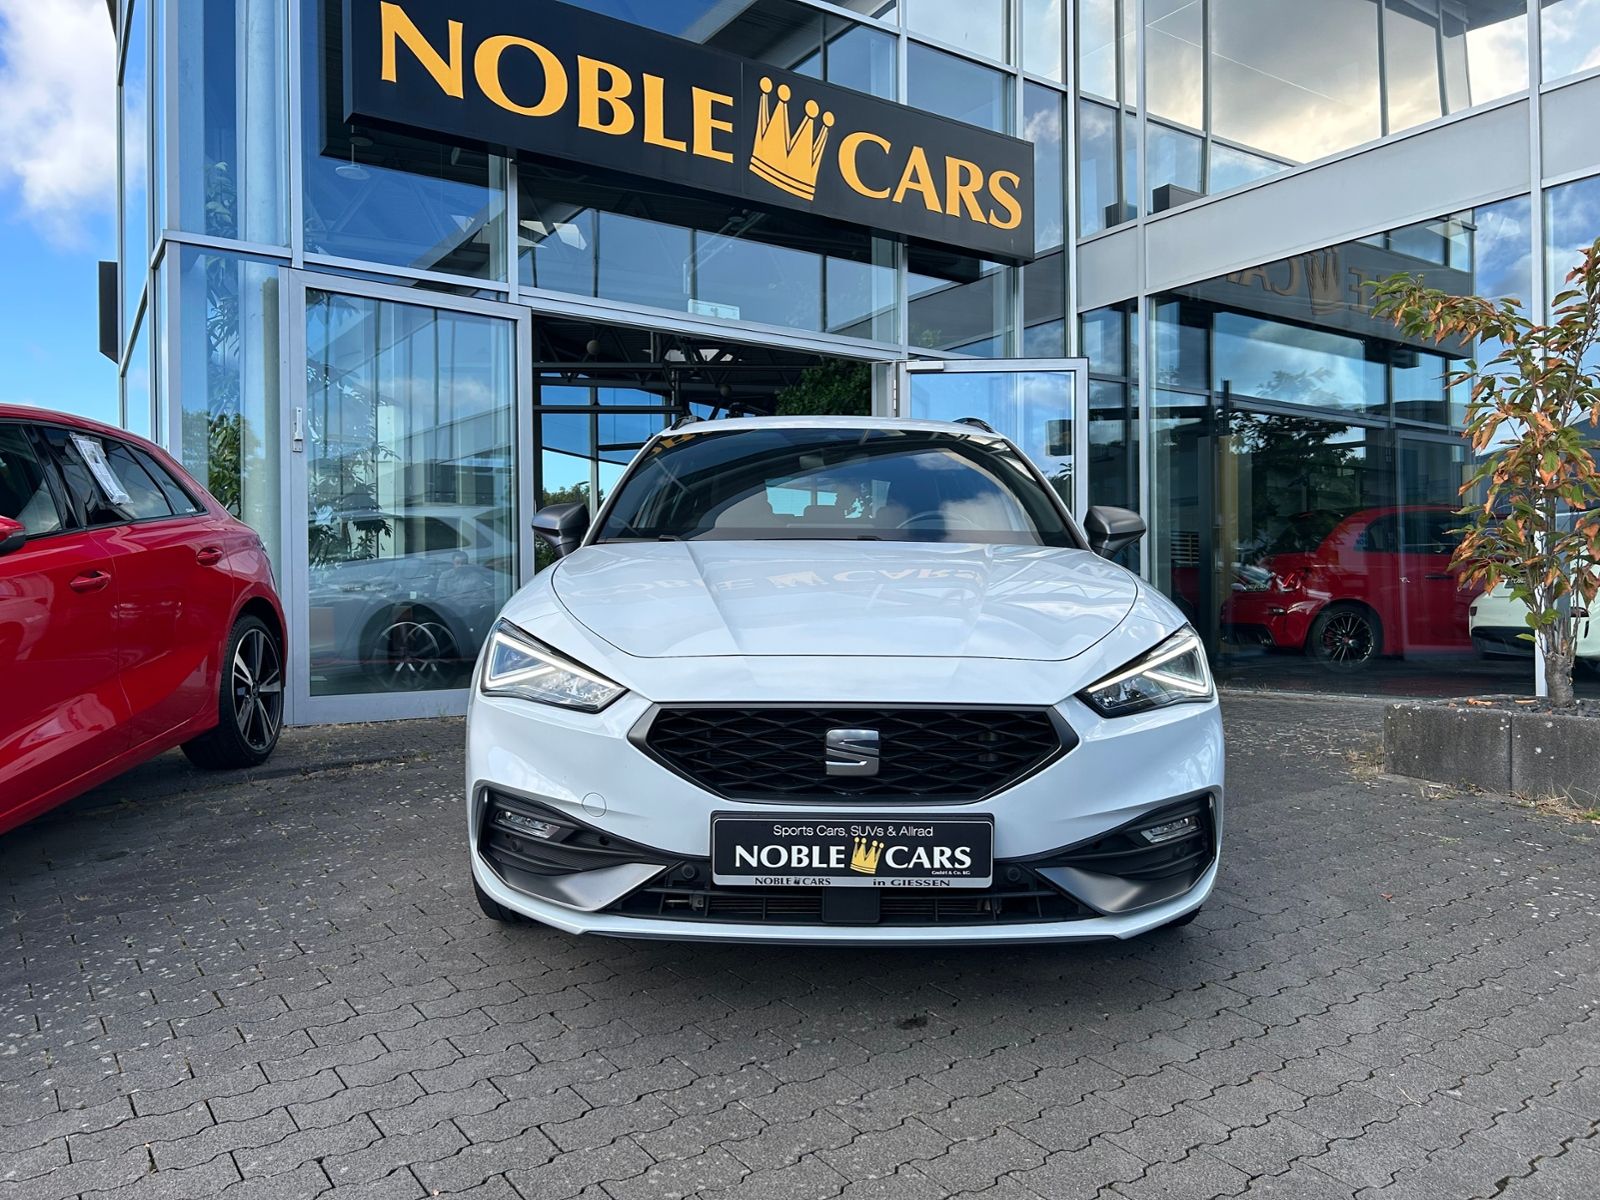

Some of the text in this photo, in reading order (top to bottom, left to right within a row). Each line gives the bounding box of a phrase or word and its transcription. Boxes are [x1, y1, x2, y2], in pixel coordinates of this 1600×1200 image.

[379, 2, 1022, 230] NOBLE CARS
[773, 824, 934, 838] Sports Cars, SUVs & Allrad
[735, 845, 972, 869] NOBLE CARS
[754, 877, 831, 886] NOBLE CARS
[873, 878, 950, 887] in GIESSEN
